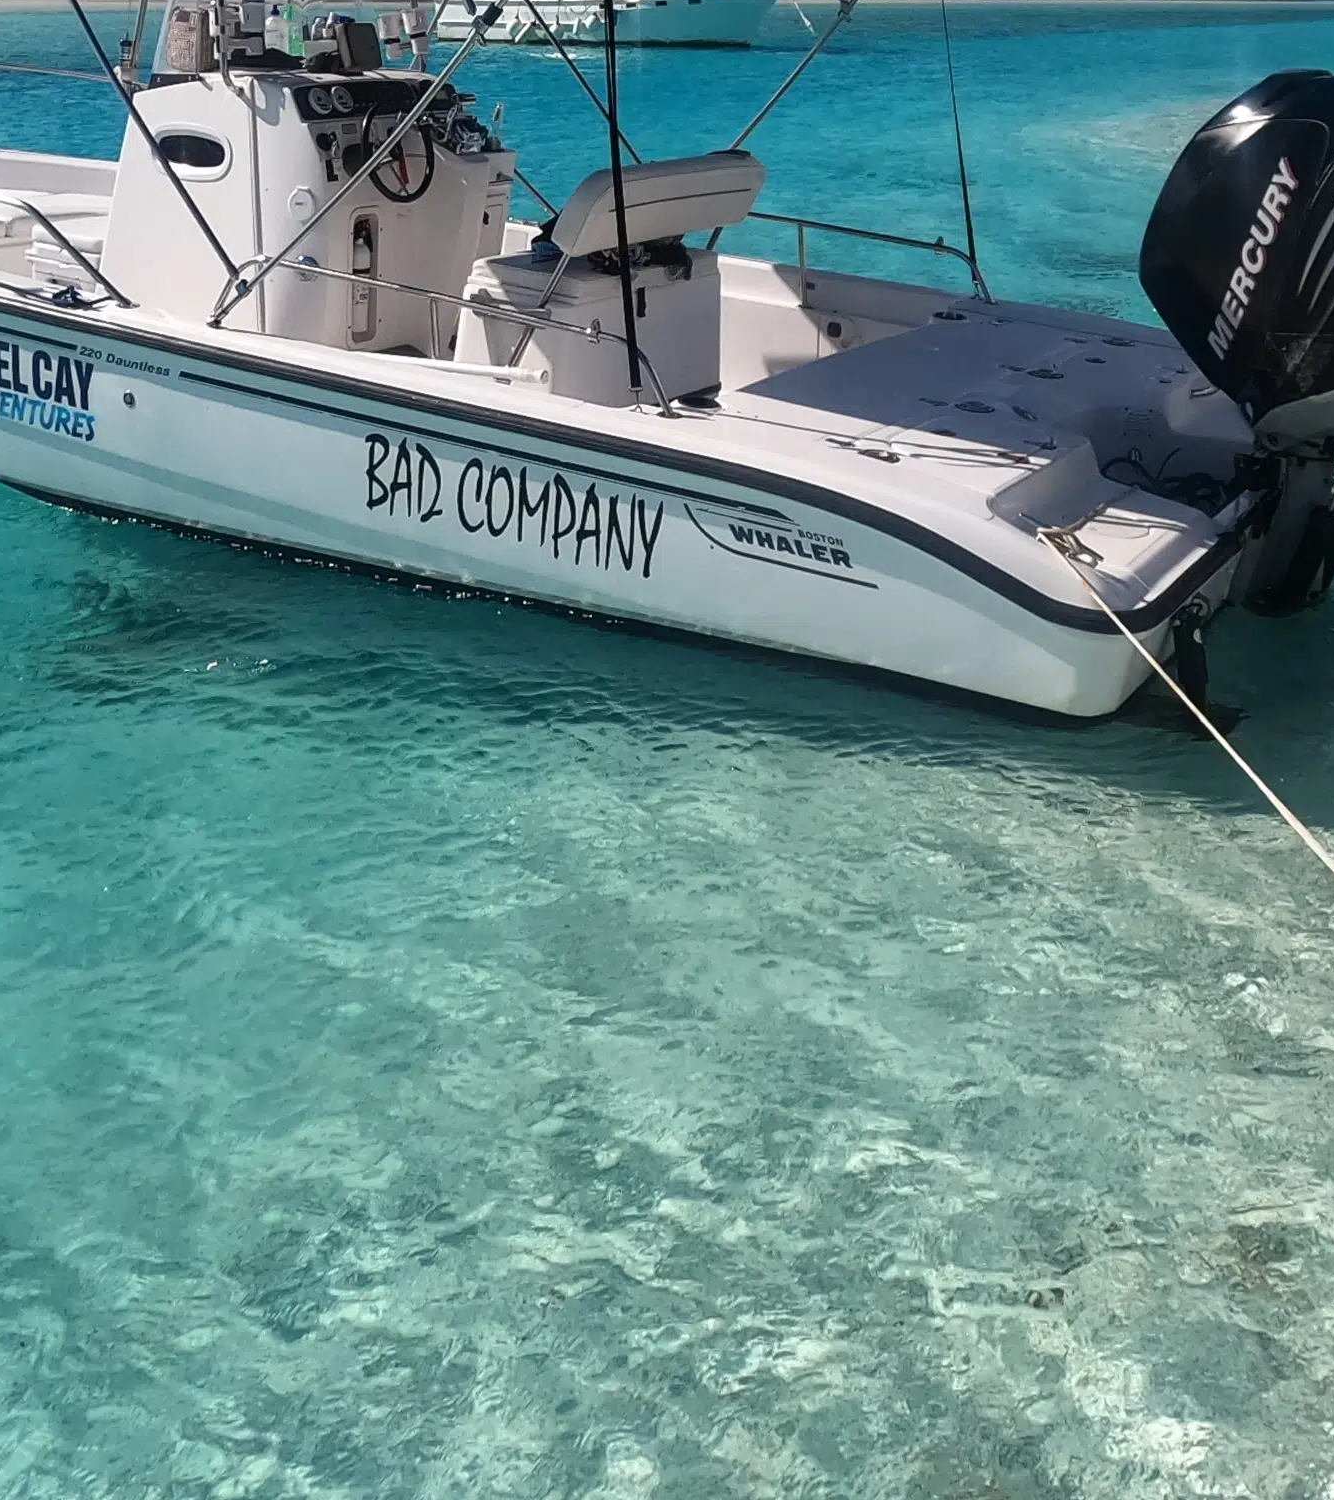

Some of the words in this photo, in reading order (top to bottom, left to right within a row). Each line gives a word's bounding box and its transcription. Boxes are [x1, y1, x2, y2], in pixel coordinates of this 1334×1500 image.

[1206, 156, 1299, 360] MERCURY
[32, 349, 94, 410] CAY
[79, 346, 102, 360] 220
[105, 352, 171, 377] Dauntless
[365, 433, 443, 523] BAD
[457, 458, 664, 578] COMPANY
[728, 523, 853, 569] WHALER
[798, 529, 844, 547] BOSTON
